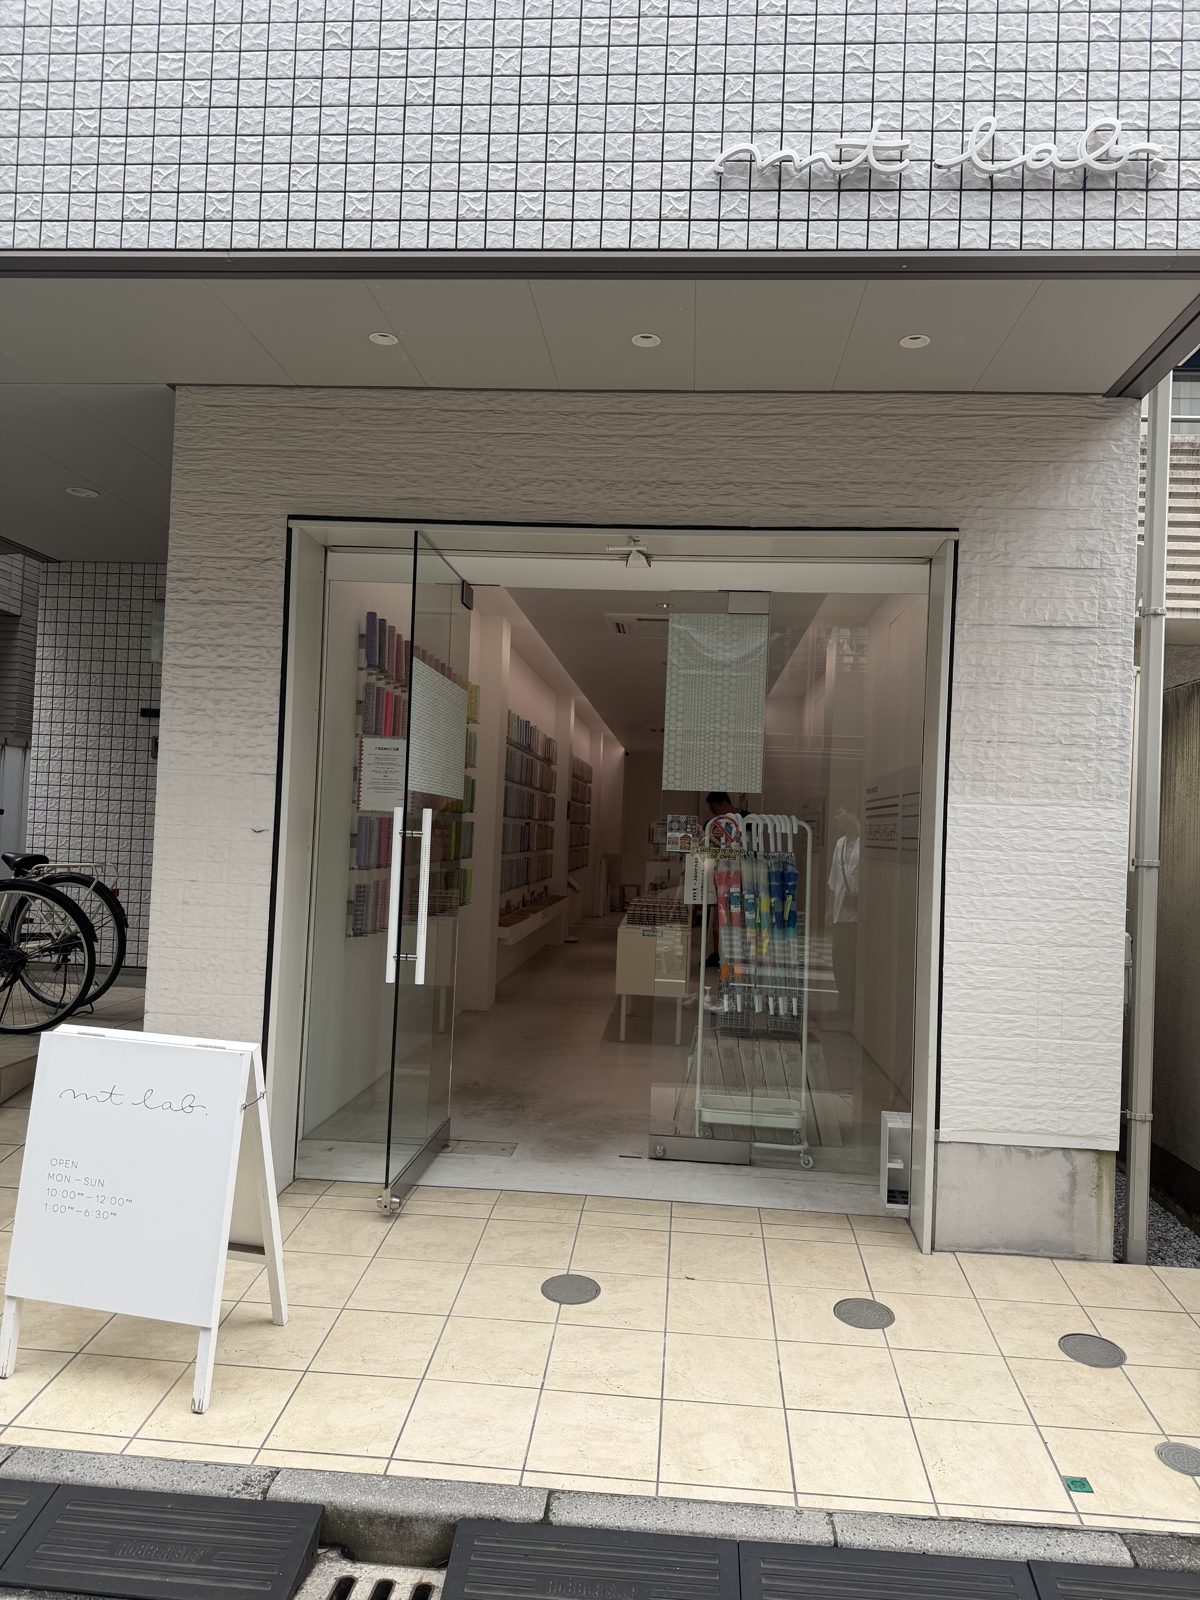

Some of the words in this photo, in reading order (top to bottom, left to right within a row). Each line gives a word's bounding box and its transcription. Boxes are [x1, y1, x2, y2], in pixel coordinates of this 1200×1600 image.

[714, 118, 910, 176] mt
[59, 1084, 124, 1106] mt
[50, 1157, 79, 1169] OPEN
